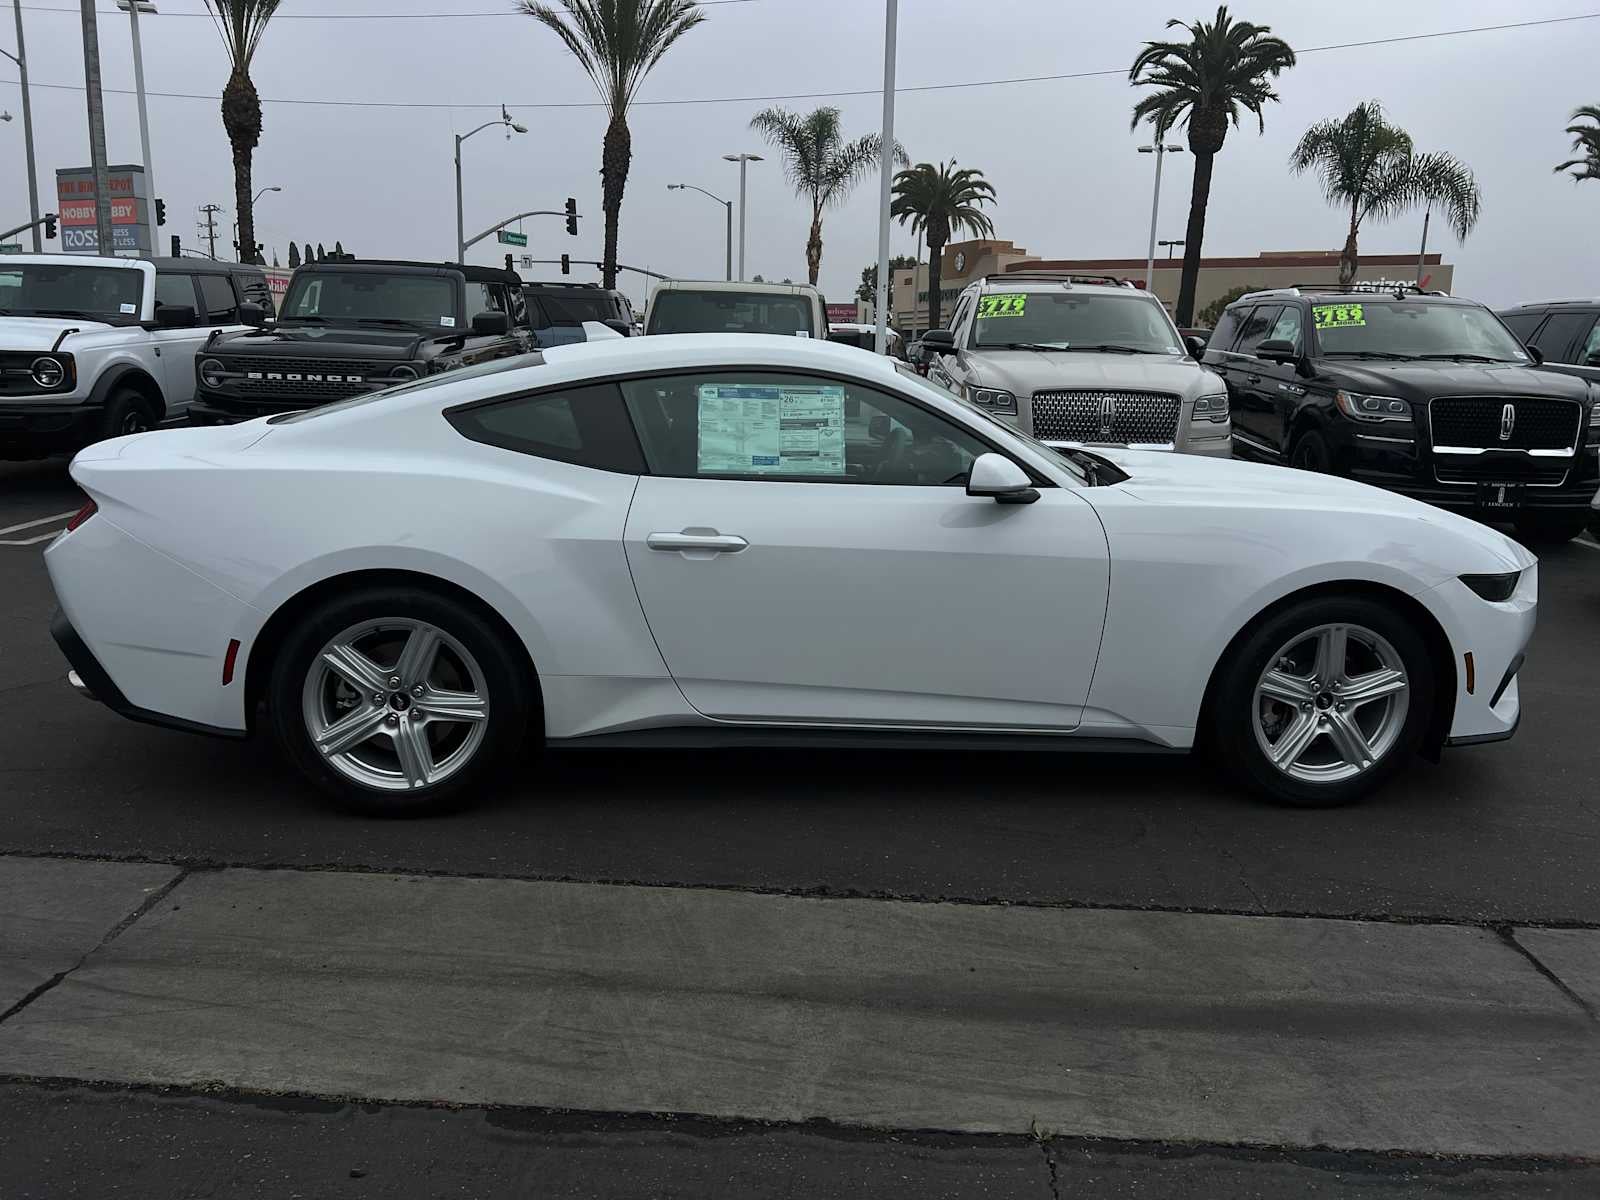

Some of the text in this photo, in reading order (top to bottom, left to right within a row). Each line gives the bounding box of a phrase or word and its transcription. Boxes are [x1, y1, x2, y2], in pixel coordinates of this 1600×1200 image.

[62, 205, 132, 219] HOBBY BBY
[979, 299, 1025, 312] $779
[1314, 309, 1362, 322] $789
[247, 372, 362, 382] BRONCO
